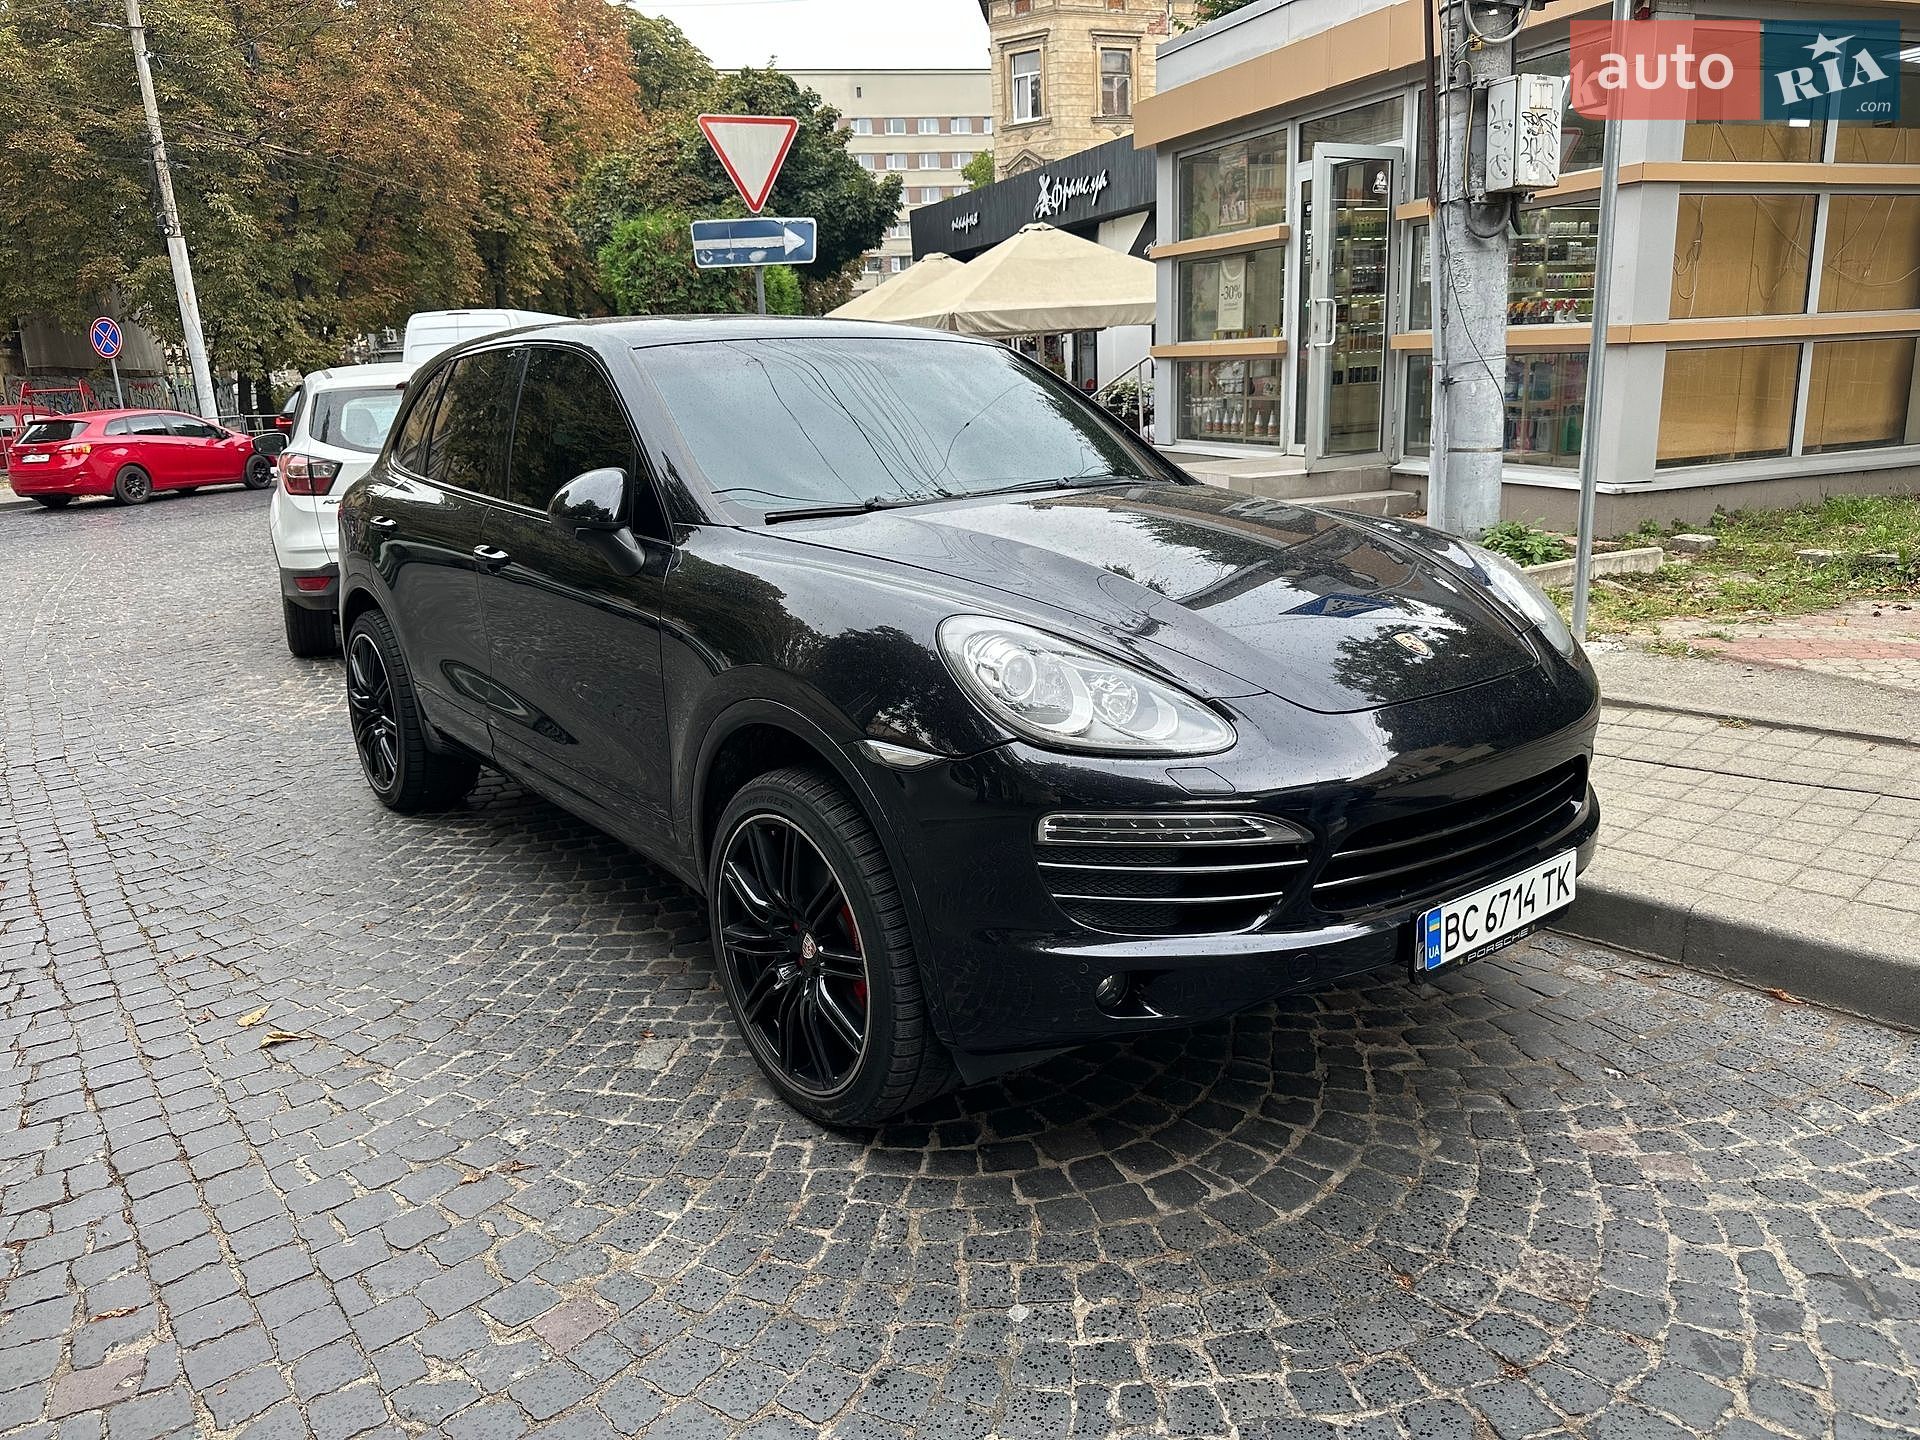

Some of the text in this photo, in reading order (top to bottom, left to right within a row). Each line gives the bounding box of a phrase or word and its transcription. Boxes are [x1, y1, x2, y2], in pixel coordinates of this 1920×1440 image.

[1221, 284, 1242, 300] -30%
[1445, 861, 1571, 953] BC 6714 TK
[1429, 945, 1440, 959] UA
[1467, 928, 1529, 962] PORSCHE
